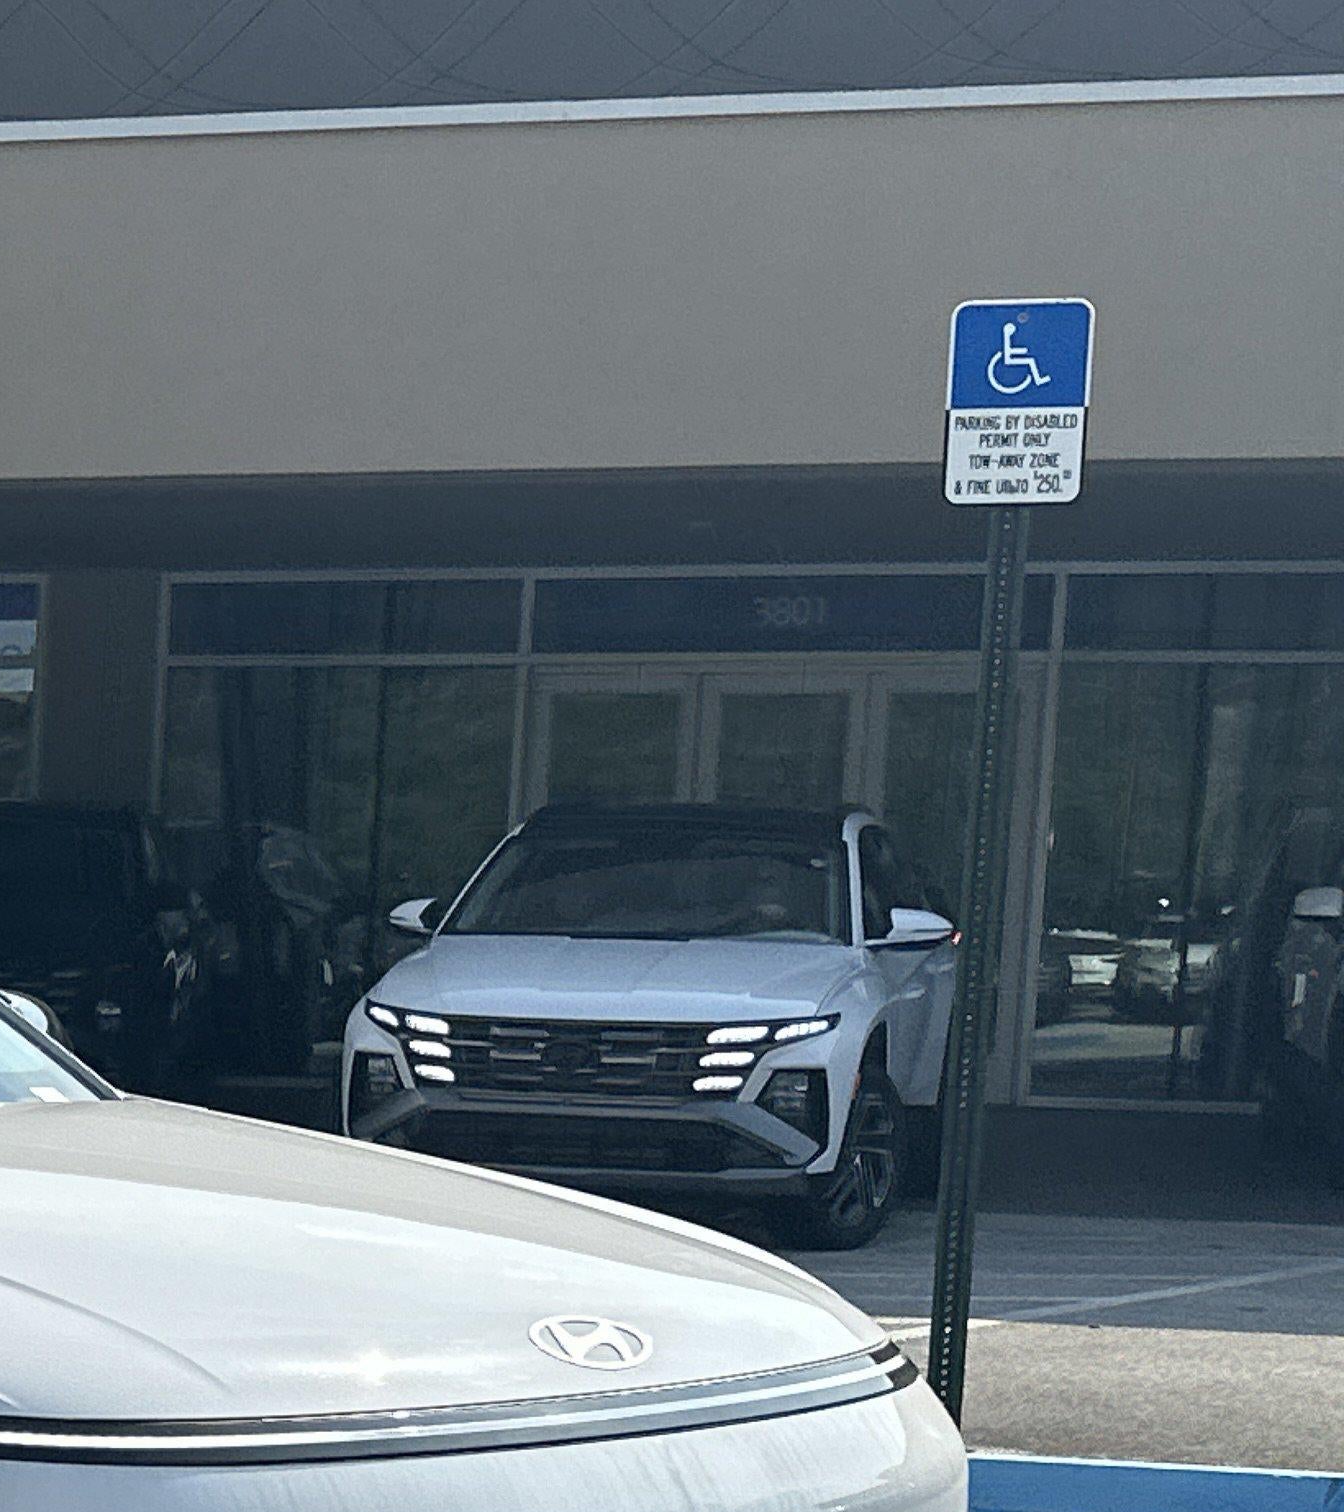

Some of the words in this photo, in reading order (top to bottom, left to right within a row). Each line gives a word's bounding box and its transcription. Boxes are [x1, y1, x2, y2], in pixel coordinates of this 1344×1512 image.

[954, 415, 1002, 431] PARKING
[1006, 415, 1020, 430] BY
[1024, 413, 1078, 430] DISABLED
[979, 433, 1019, 448] PERMIT
[1023, 432, 1051, 448] ONLY
[1029, 452, 1061, 468] ZONE
[954, 480, 963, 495] &
[967, 479, 992, 495] FINE
